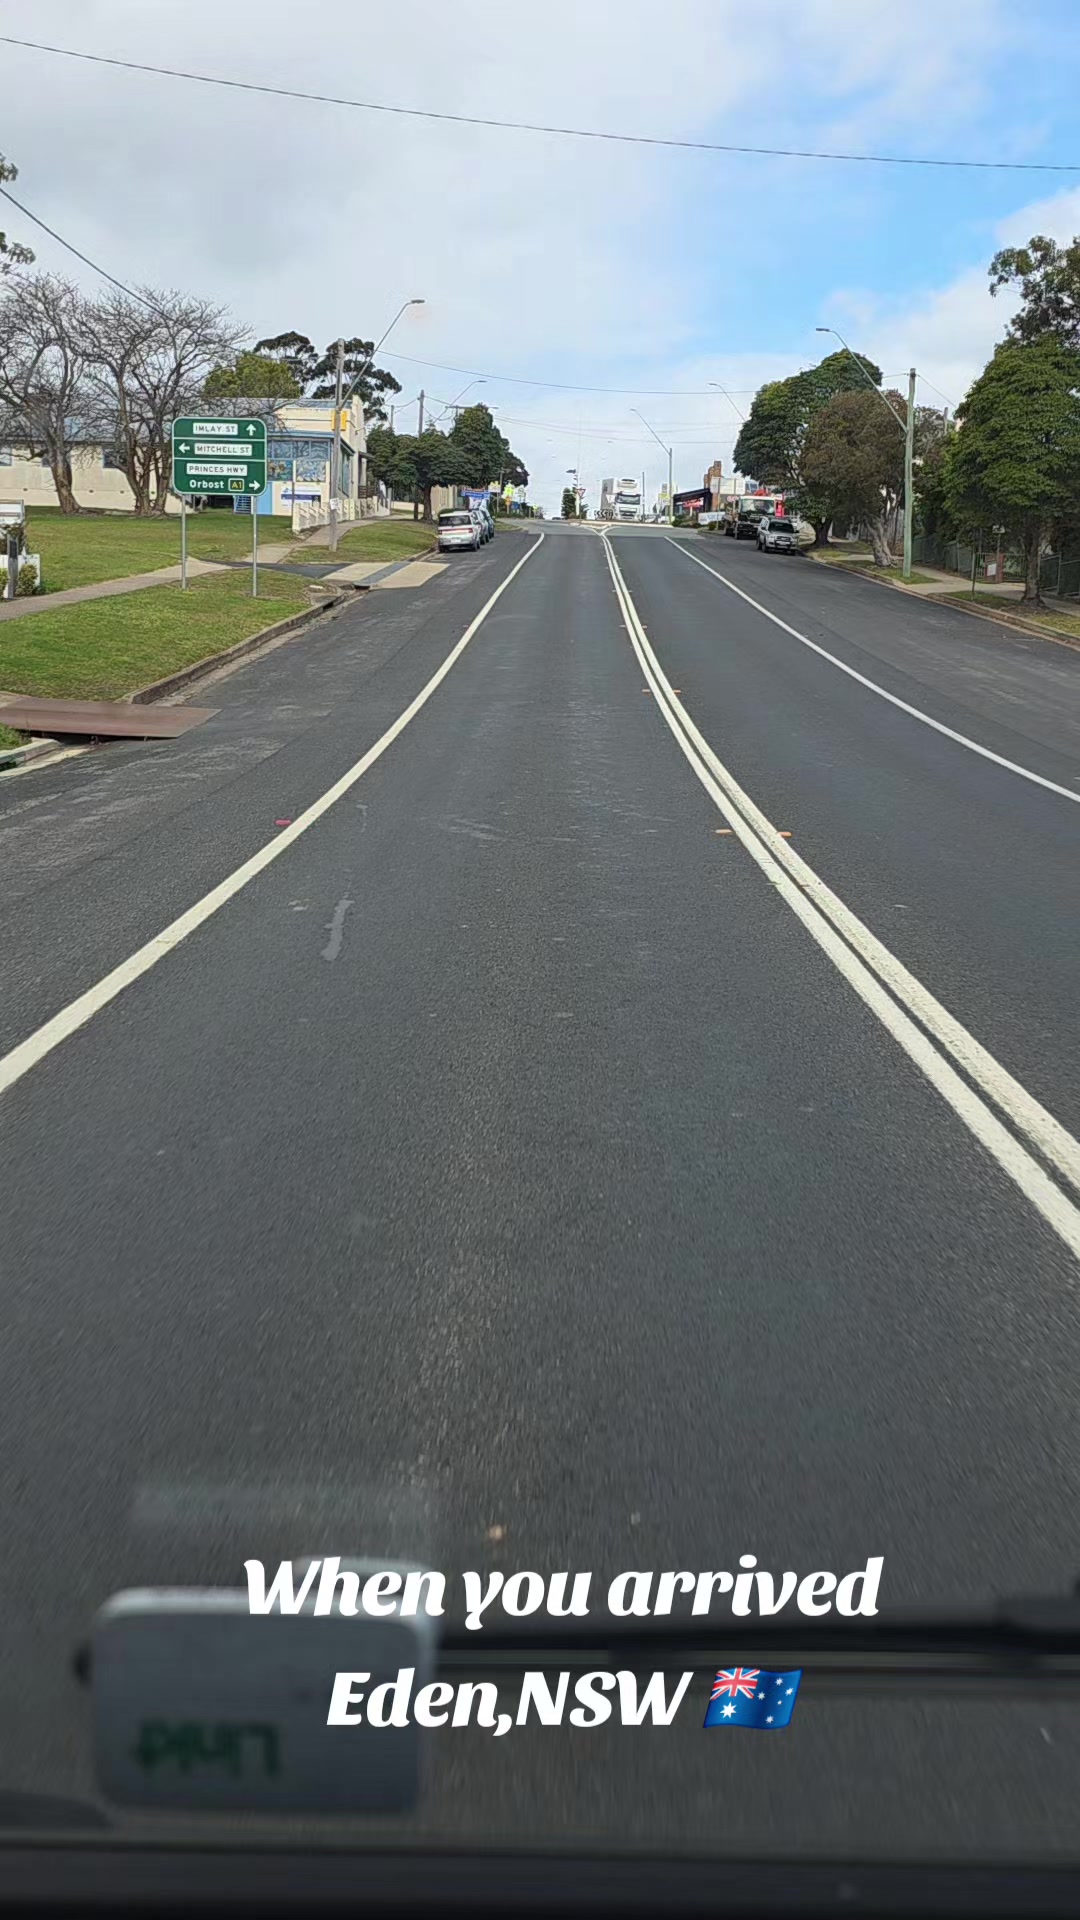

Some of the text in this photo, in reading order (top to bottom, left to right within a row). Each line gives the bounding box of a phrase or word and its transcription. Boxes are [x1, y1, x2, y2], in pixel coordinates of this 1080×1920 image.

[196, 446, 237, 454] MITCHELL
[188, 465, 225, 473] PRINCES
[189, 479, 243, 489] Orbost A1
